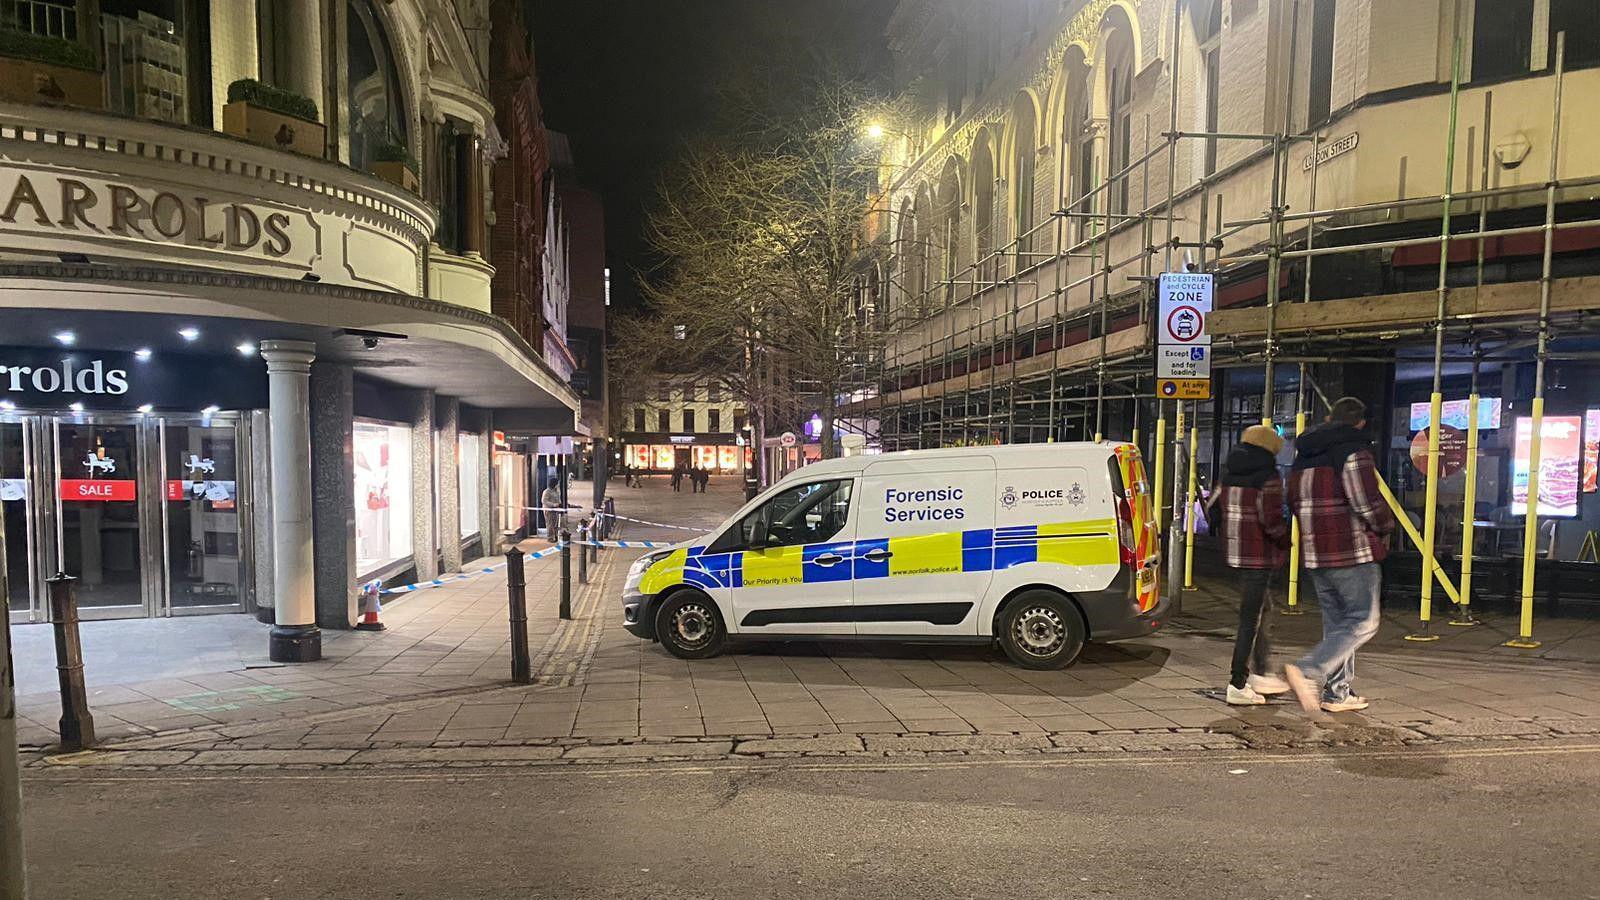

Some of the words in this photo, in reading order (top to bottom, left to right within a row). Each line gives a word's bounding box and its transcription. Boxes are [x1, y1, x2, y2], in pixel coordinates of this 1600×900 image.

[1331, 136, 1354, 155] STREET
[1162, 275, 1211, 283] PEDESTRIAN
[1169, 291, 1203, 302] ZONE
[1165, 350, 1189, 358] Except
[79, 485, 113, 496] SALE
[885, 486, 964, 503] Forensic
[1022, 490, 1063, 499] POLICE
[884, 507, 965, 522] Services
